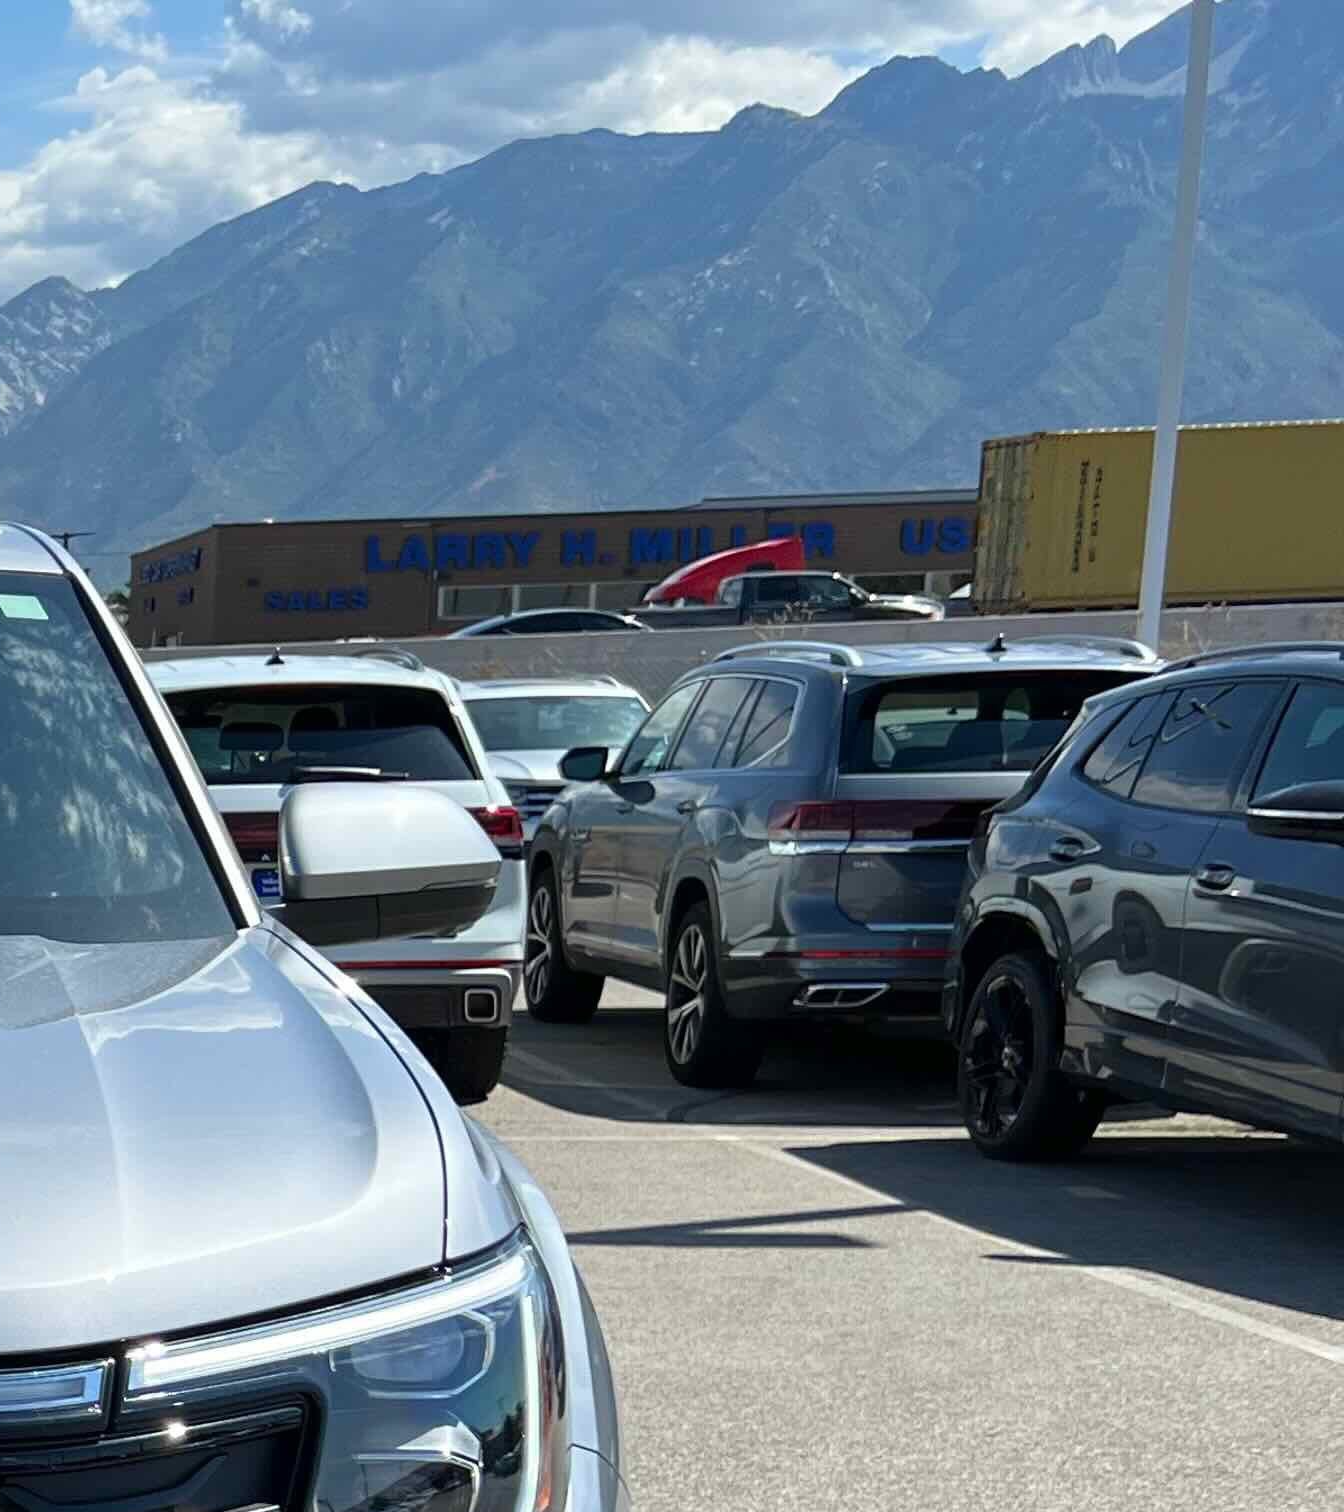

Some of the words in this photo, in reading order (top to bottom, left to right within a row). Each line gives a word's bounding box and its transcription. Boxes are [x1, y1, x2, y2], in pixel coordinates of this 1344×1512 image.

[365, 529, 541, 573] LARRY
[562, 528, 617, 568] H.
[263, 585, 369, 612] SALES
